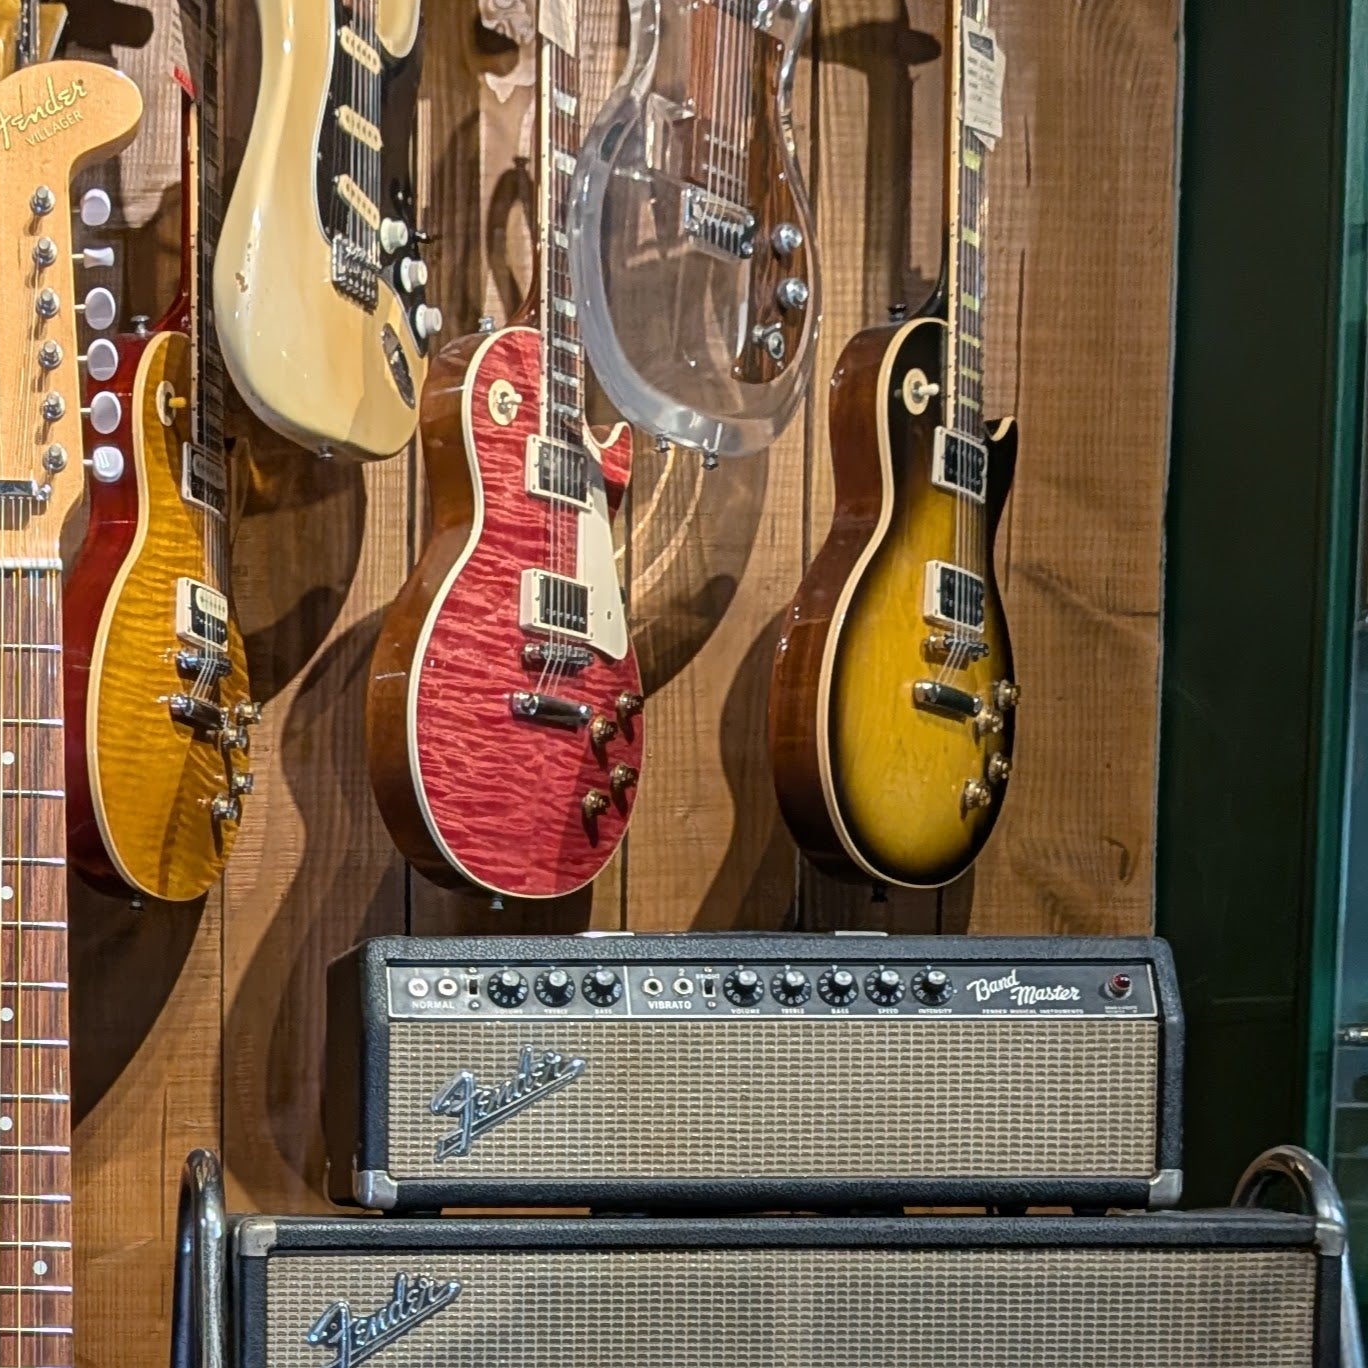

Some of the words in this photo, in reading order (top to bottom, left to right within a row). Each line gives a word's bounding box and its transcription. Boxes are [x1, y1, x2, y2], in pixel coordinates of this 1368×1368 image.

[25, 109, 84, 147] VILLAGER
[966, 969, 1020, 1002] Band
[412, 1000, 455, 1009] NORMAL
[648, 1001, 692, 1010] VIBRATO
[430, 1045, 587, 1160] Fender
